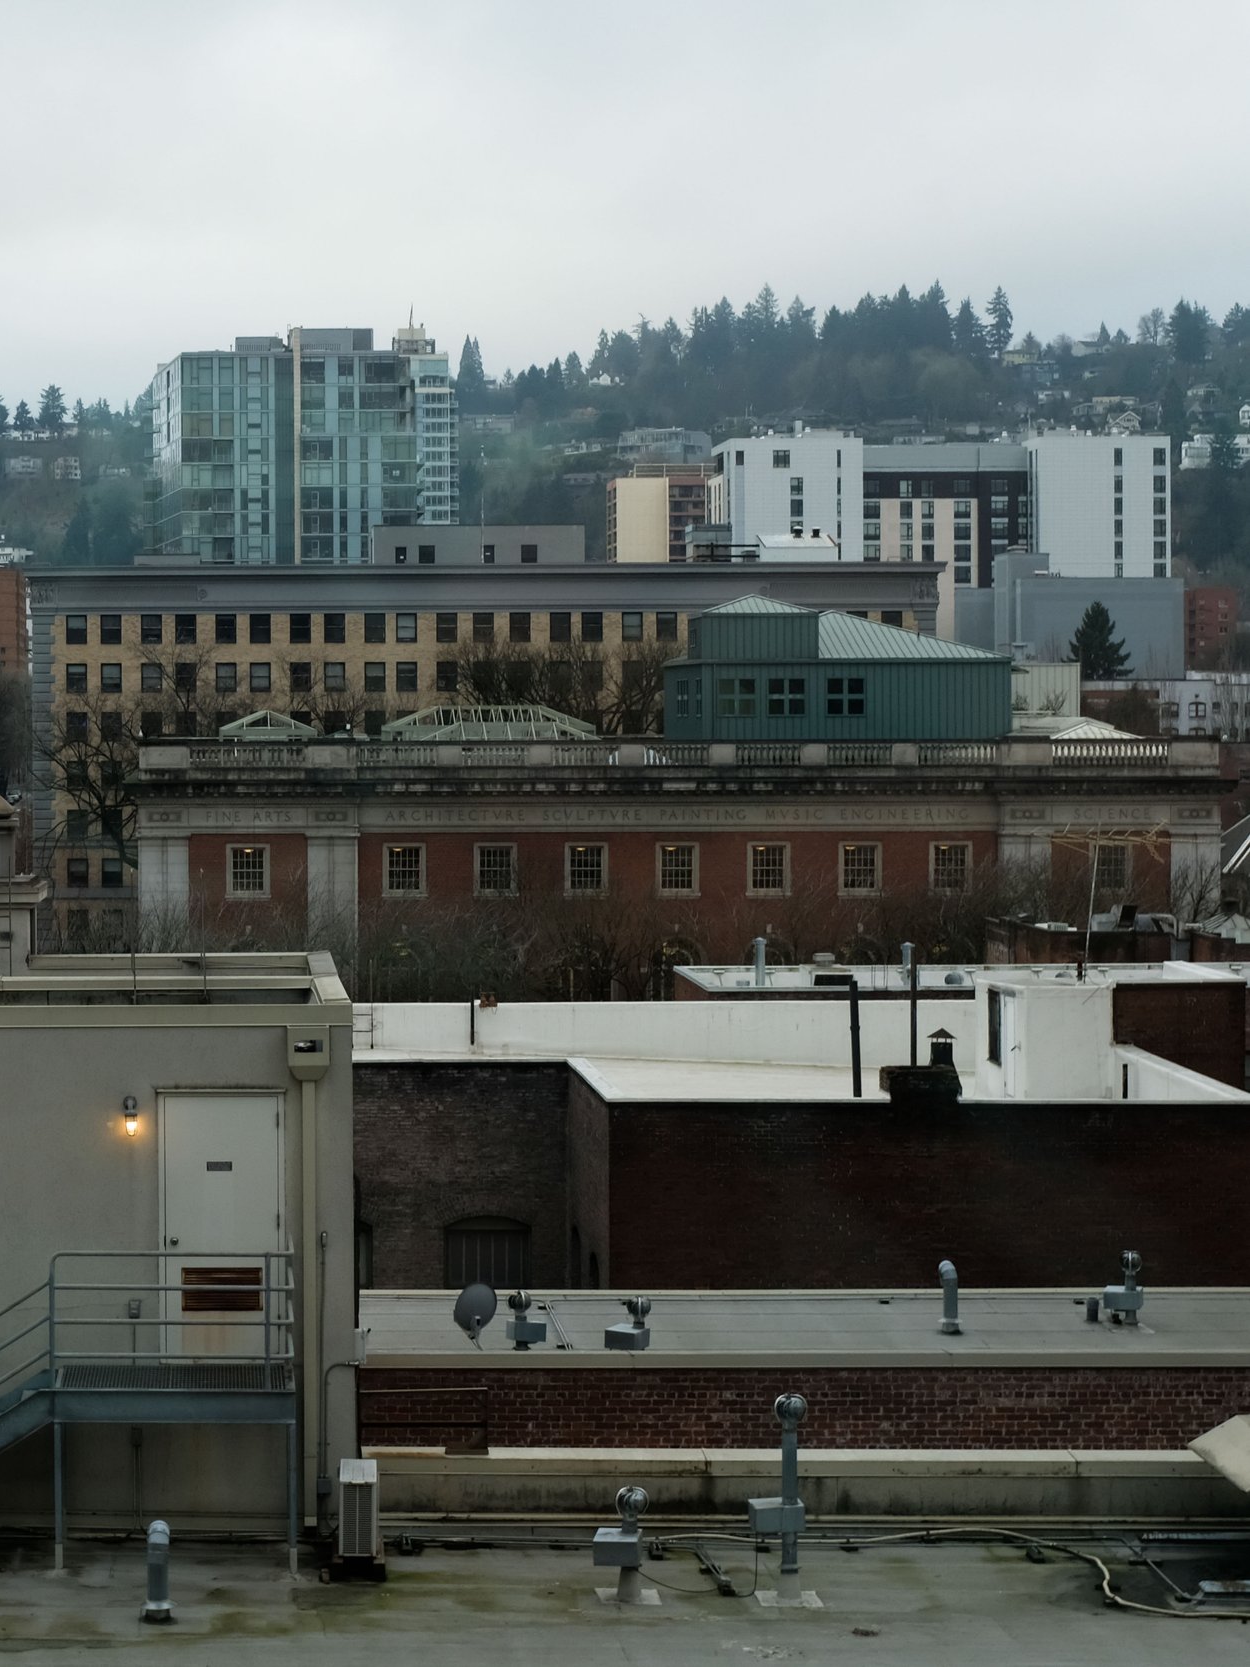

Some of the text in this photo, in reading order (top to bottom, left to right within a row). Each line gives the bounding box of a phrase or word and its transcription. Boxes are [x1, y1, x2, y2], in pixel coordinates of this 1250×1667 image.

[205, 810, 293, 823] FINE ARTS
[385, 807, 970, 822] ARCHITECTVRE SCVLPTVRE PAINTING MVSIC ENGINEERING
[1073, 807, 1152, 820] SCIENCE
